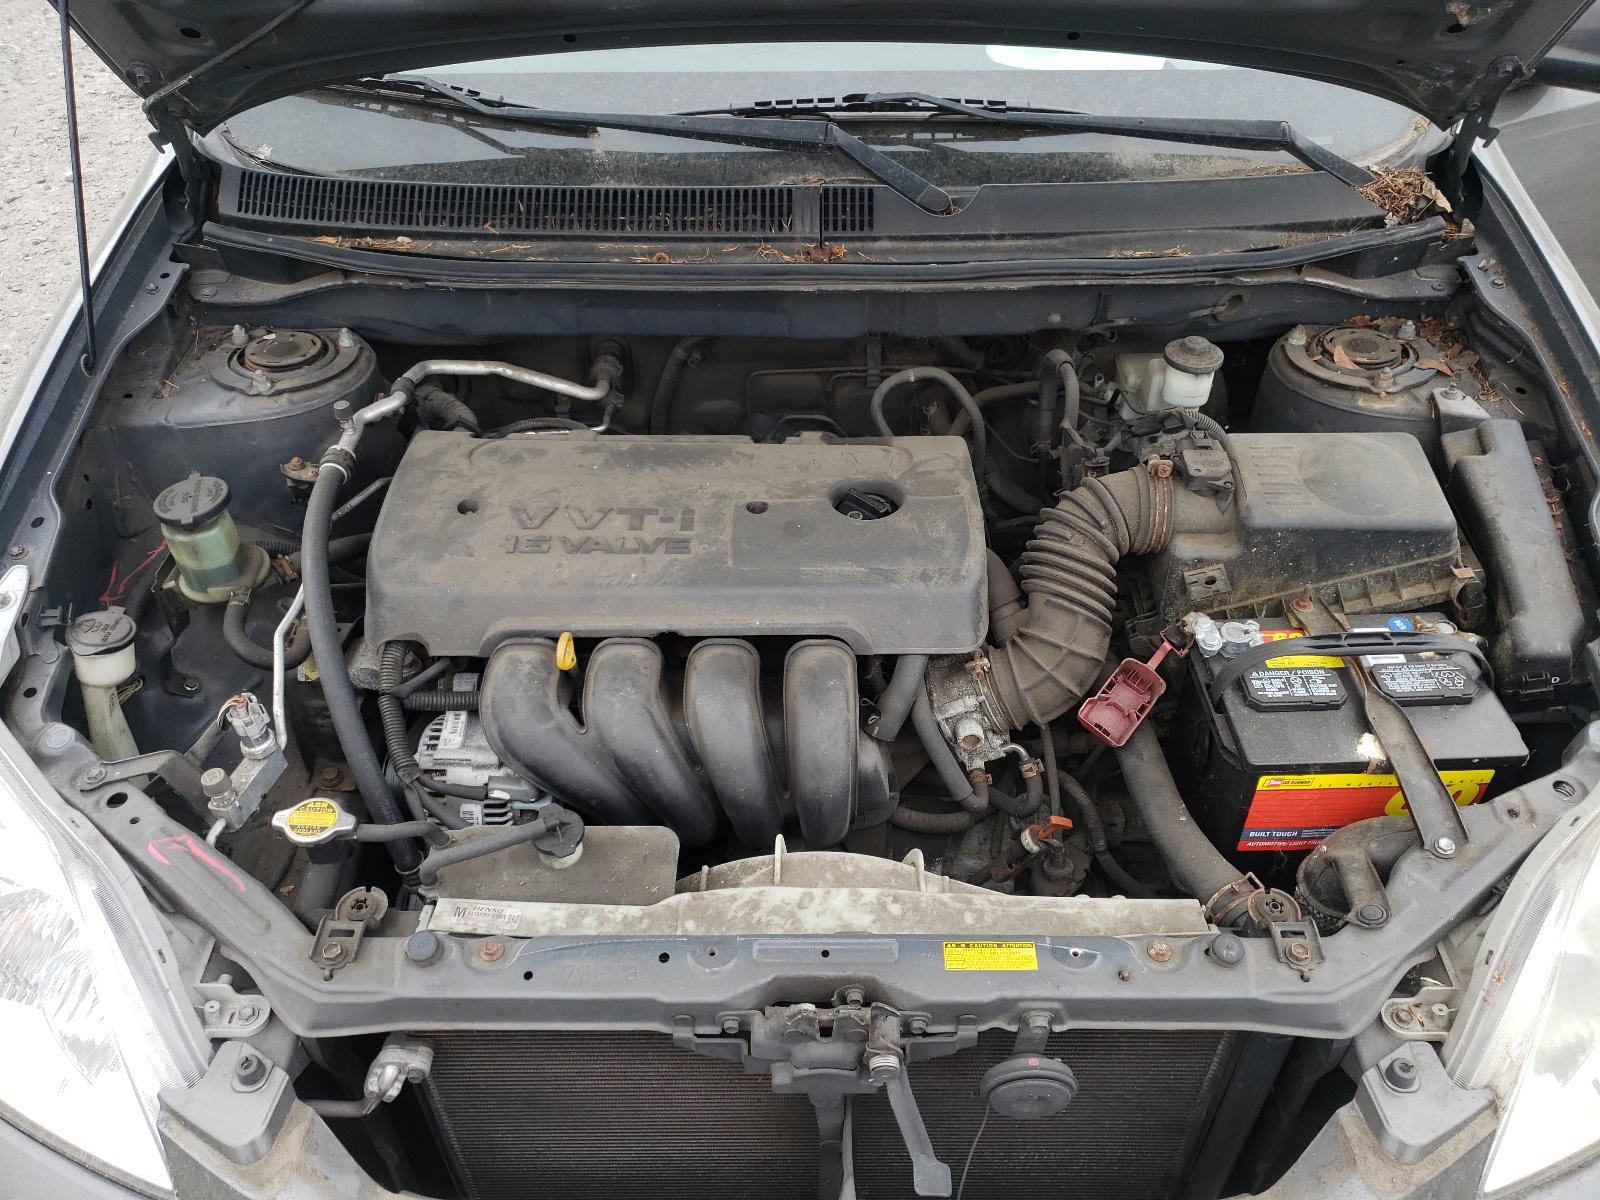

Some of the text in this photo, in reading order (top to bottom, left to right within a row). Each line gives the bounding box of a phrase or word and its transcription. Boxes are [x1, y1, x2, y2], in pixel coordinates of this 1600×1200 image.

[504, 535, 694, 555] 16 VALVE
[453, 905, 505, 918] M DENSO
